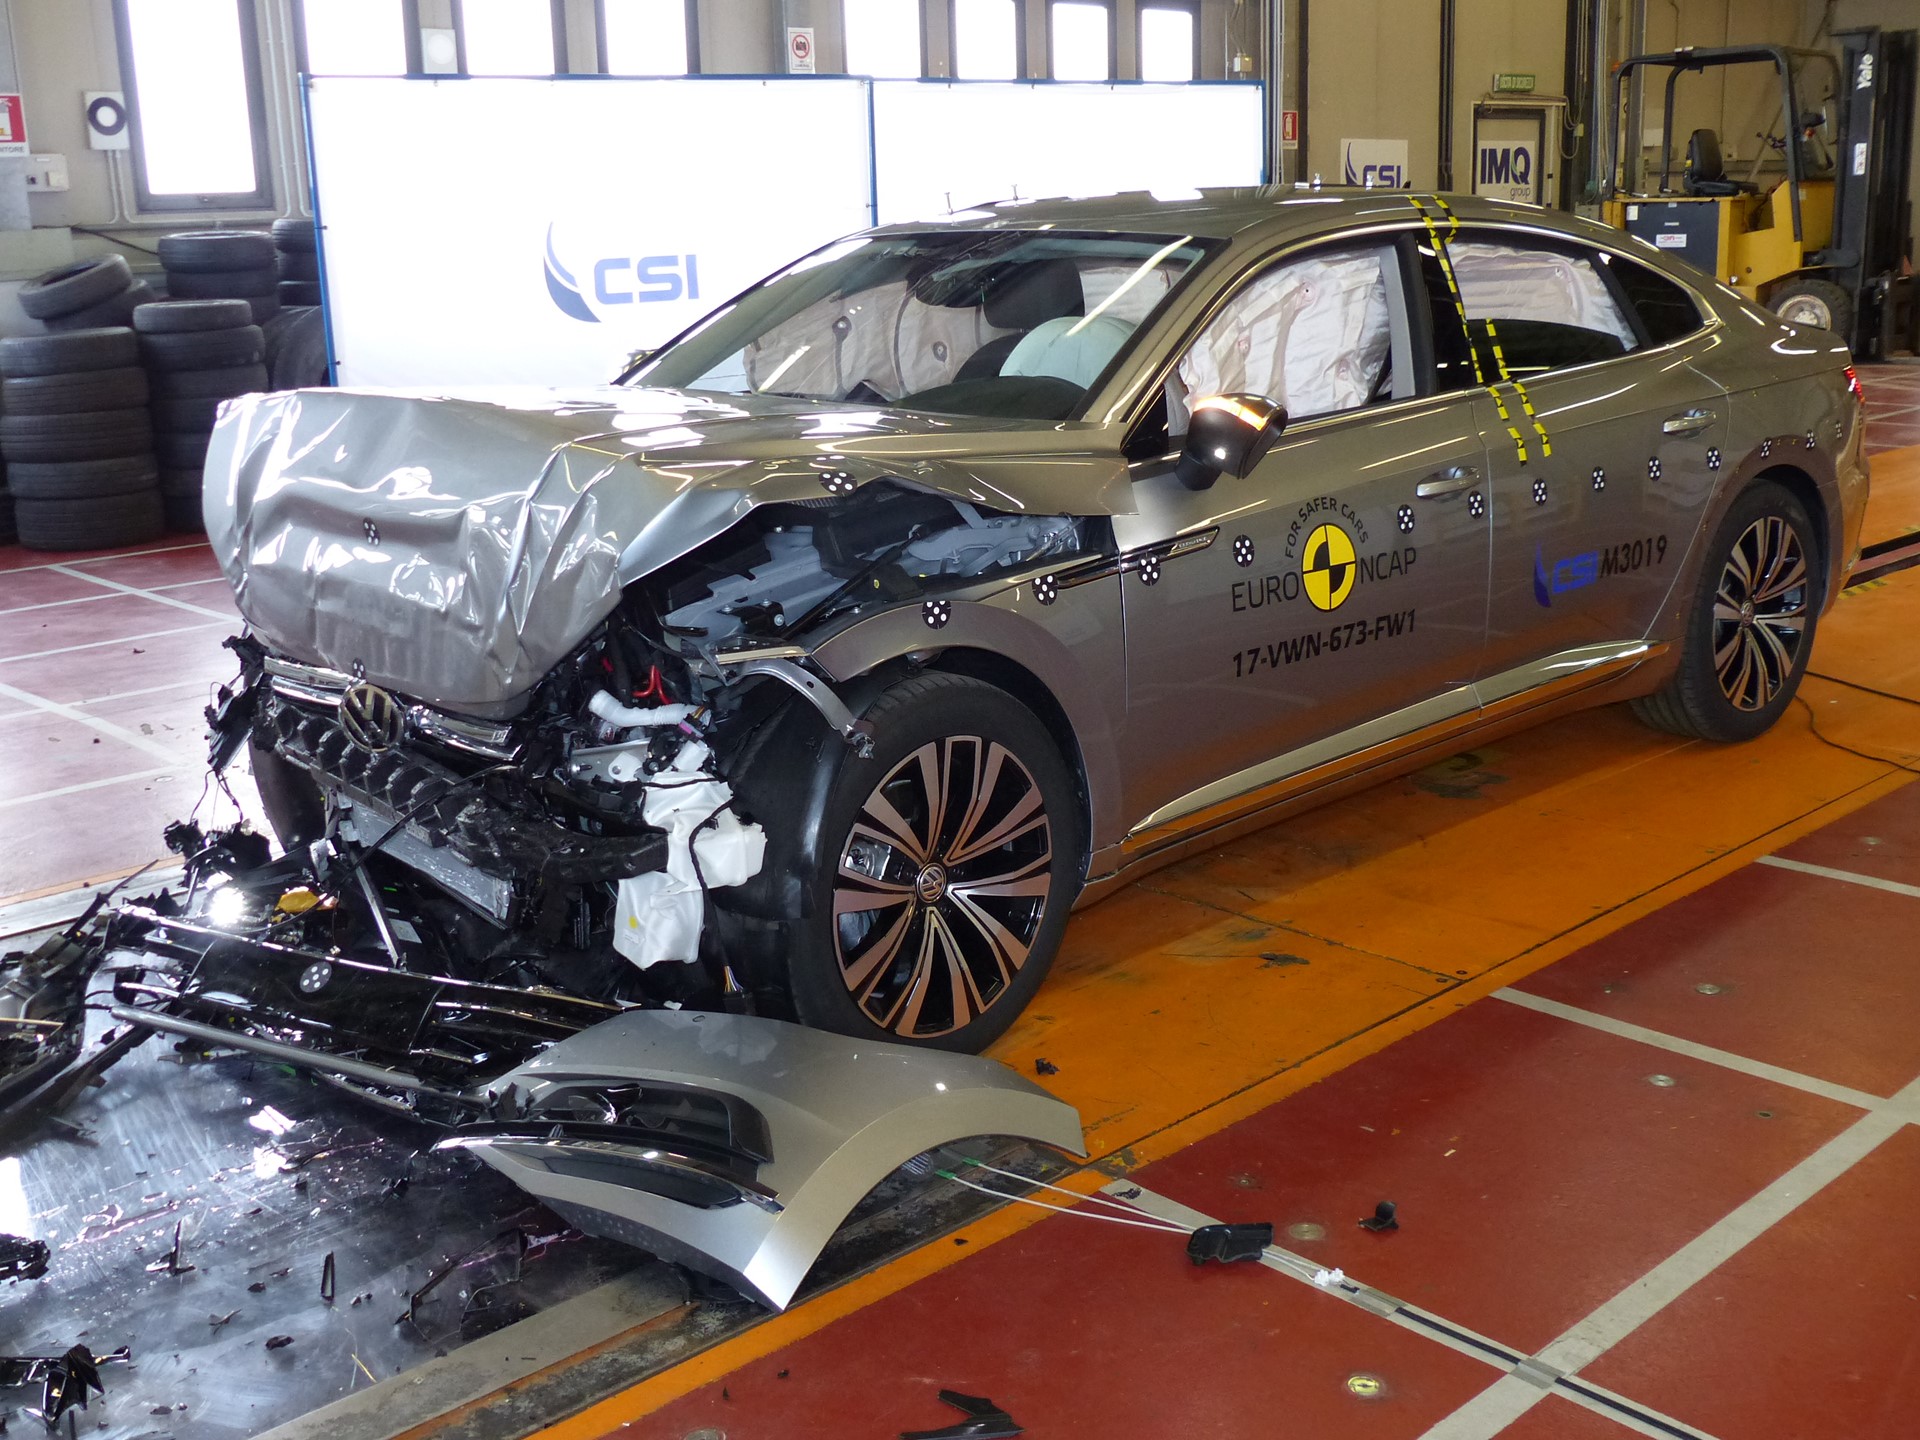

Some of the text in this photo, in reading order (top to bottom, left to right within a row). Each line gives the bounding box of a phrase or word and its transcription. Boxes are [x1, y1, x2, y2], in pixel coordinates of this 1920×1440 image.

[1856, 53, 1873, 90] Yale
[1363, 165, 1401, 188] CSI
[1480, 147, 1531, 185] IMQ
[1509, 187, 1531, 200] group
[594, 254, 700, 305] CSI
[1285, 496, 1369, 559] FOR SAFER CARS
[1231, 547, 1416, 612] EURO NCAP
[1552, 534, 1667, 594] CSI M3019
[1232, 608, 1416, 678] 17-VWN-673-FW1
